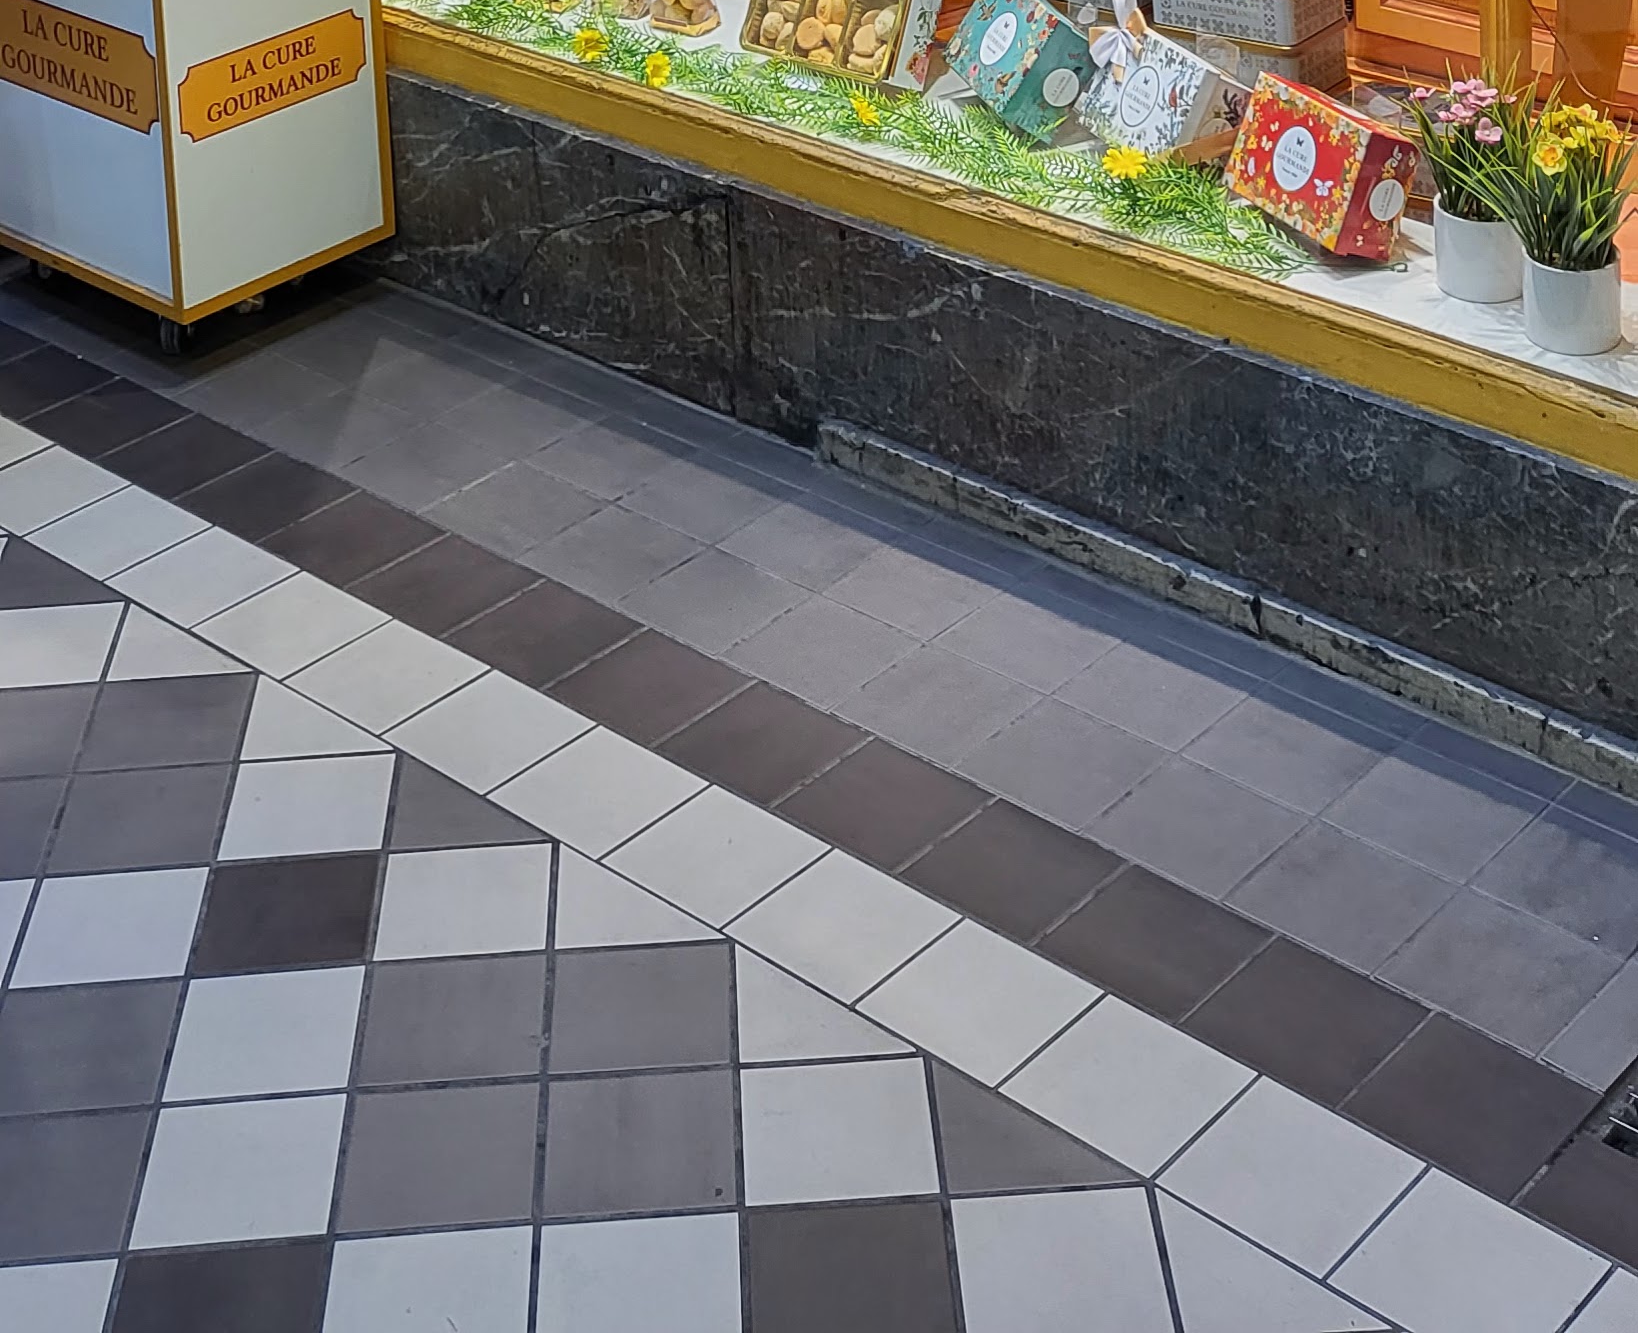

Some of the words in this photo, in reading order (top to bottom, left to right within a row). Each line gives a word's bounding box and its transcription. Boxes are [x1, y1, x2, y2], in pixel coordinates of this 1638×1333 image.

[1188, 1, 1208, 13] CURE
[21, 8, 48, 42] LA
[54, 21, 110, 63] CURE
[229, 58, 257, 83] LA
[262, 35, 317, 70] CURE
[1, 44, 139, 116] GOURMANDE
[207, 57, 343, 123] GOURMANDE
[1292, 149, 1308, 163] CURE
